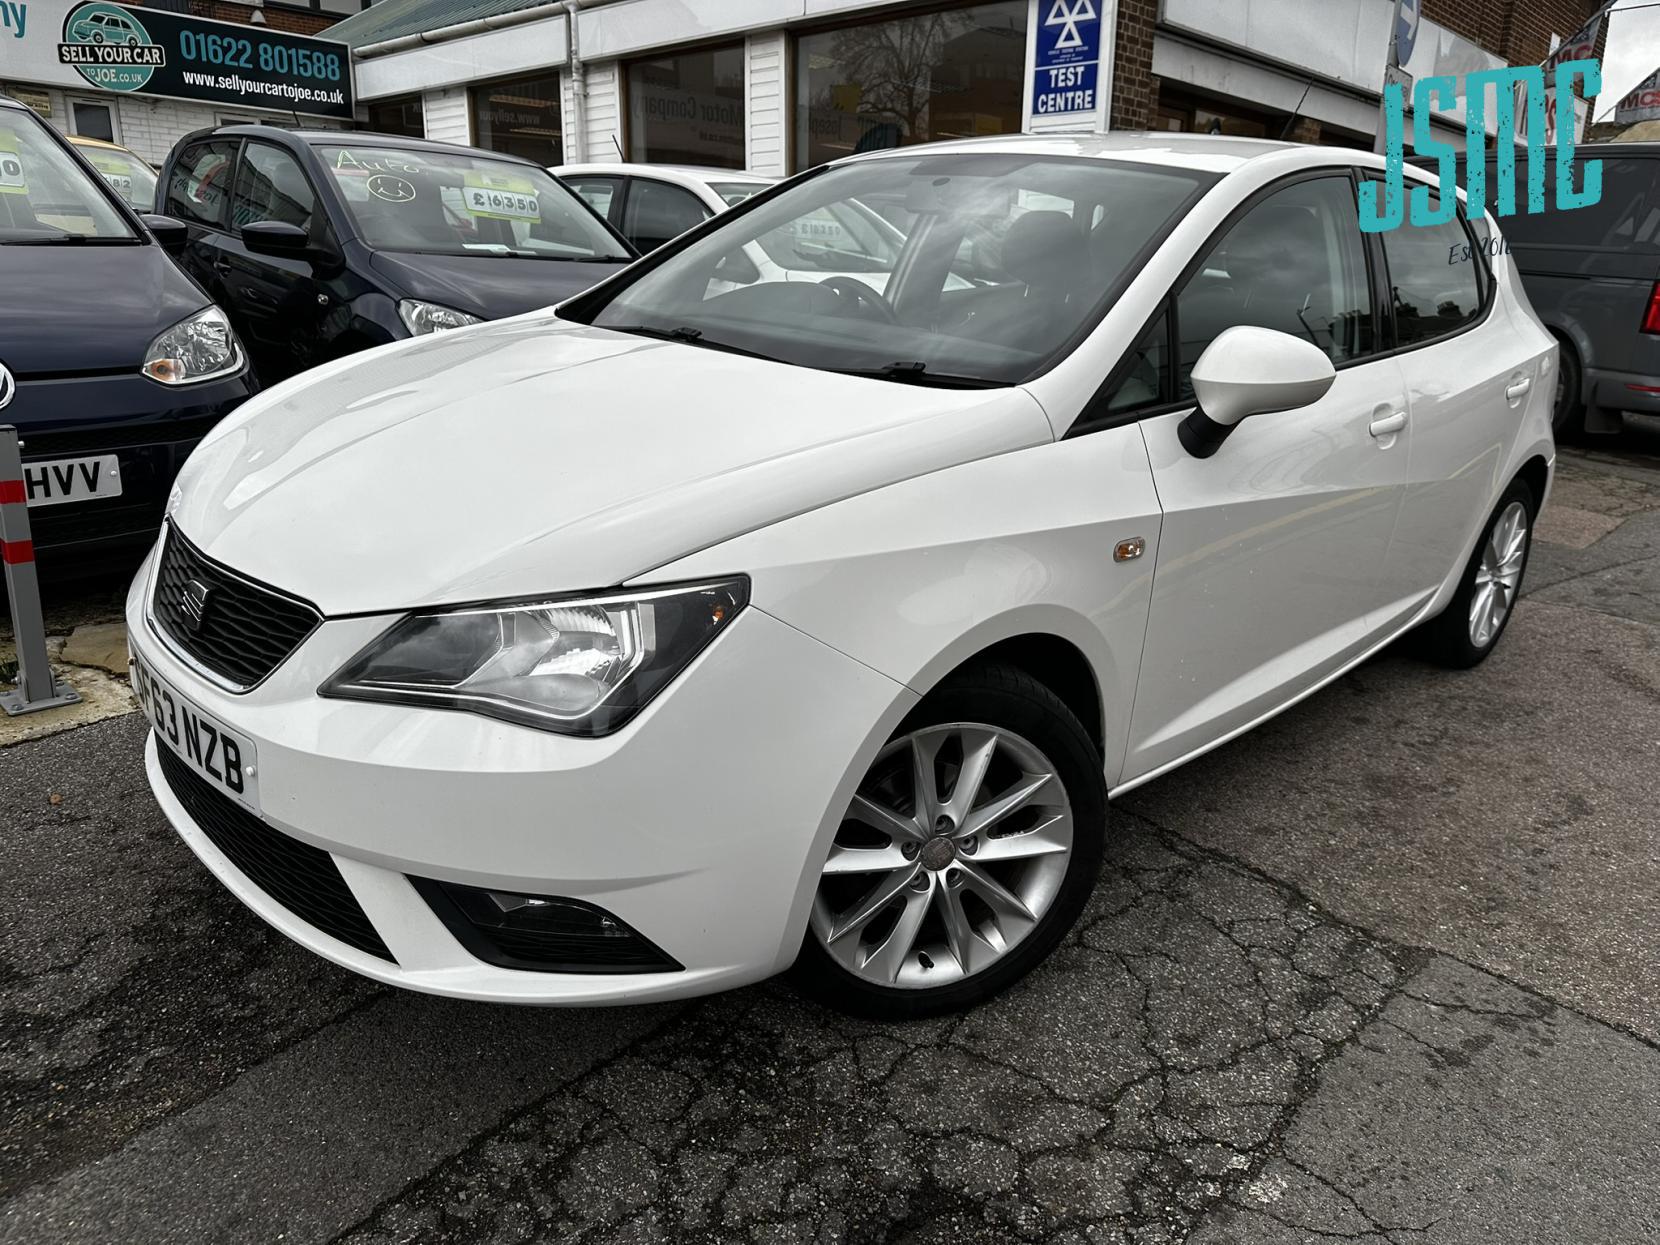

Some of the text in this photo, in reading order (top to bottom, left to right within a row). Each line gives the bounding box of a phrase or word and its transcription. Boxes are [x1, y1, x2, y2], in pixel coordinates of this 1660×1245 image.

[61, 46, 161, 64] SELL YOUR CAR
[180, 30, 340, 81] 01622 801588
[182, 71, 344, 104] www.sellyourcartojoe.co.uk
[1049, 66, 1085, 88] TEST
[1038, 89, 1093, 113] CENTRE
[337, 150, 420, 172] Auto
[24, 461, 101, 500] HVV
[182, 705, 244, 794] NZB
